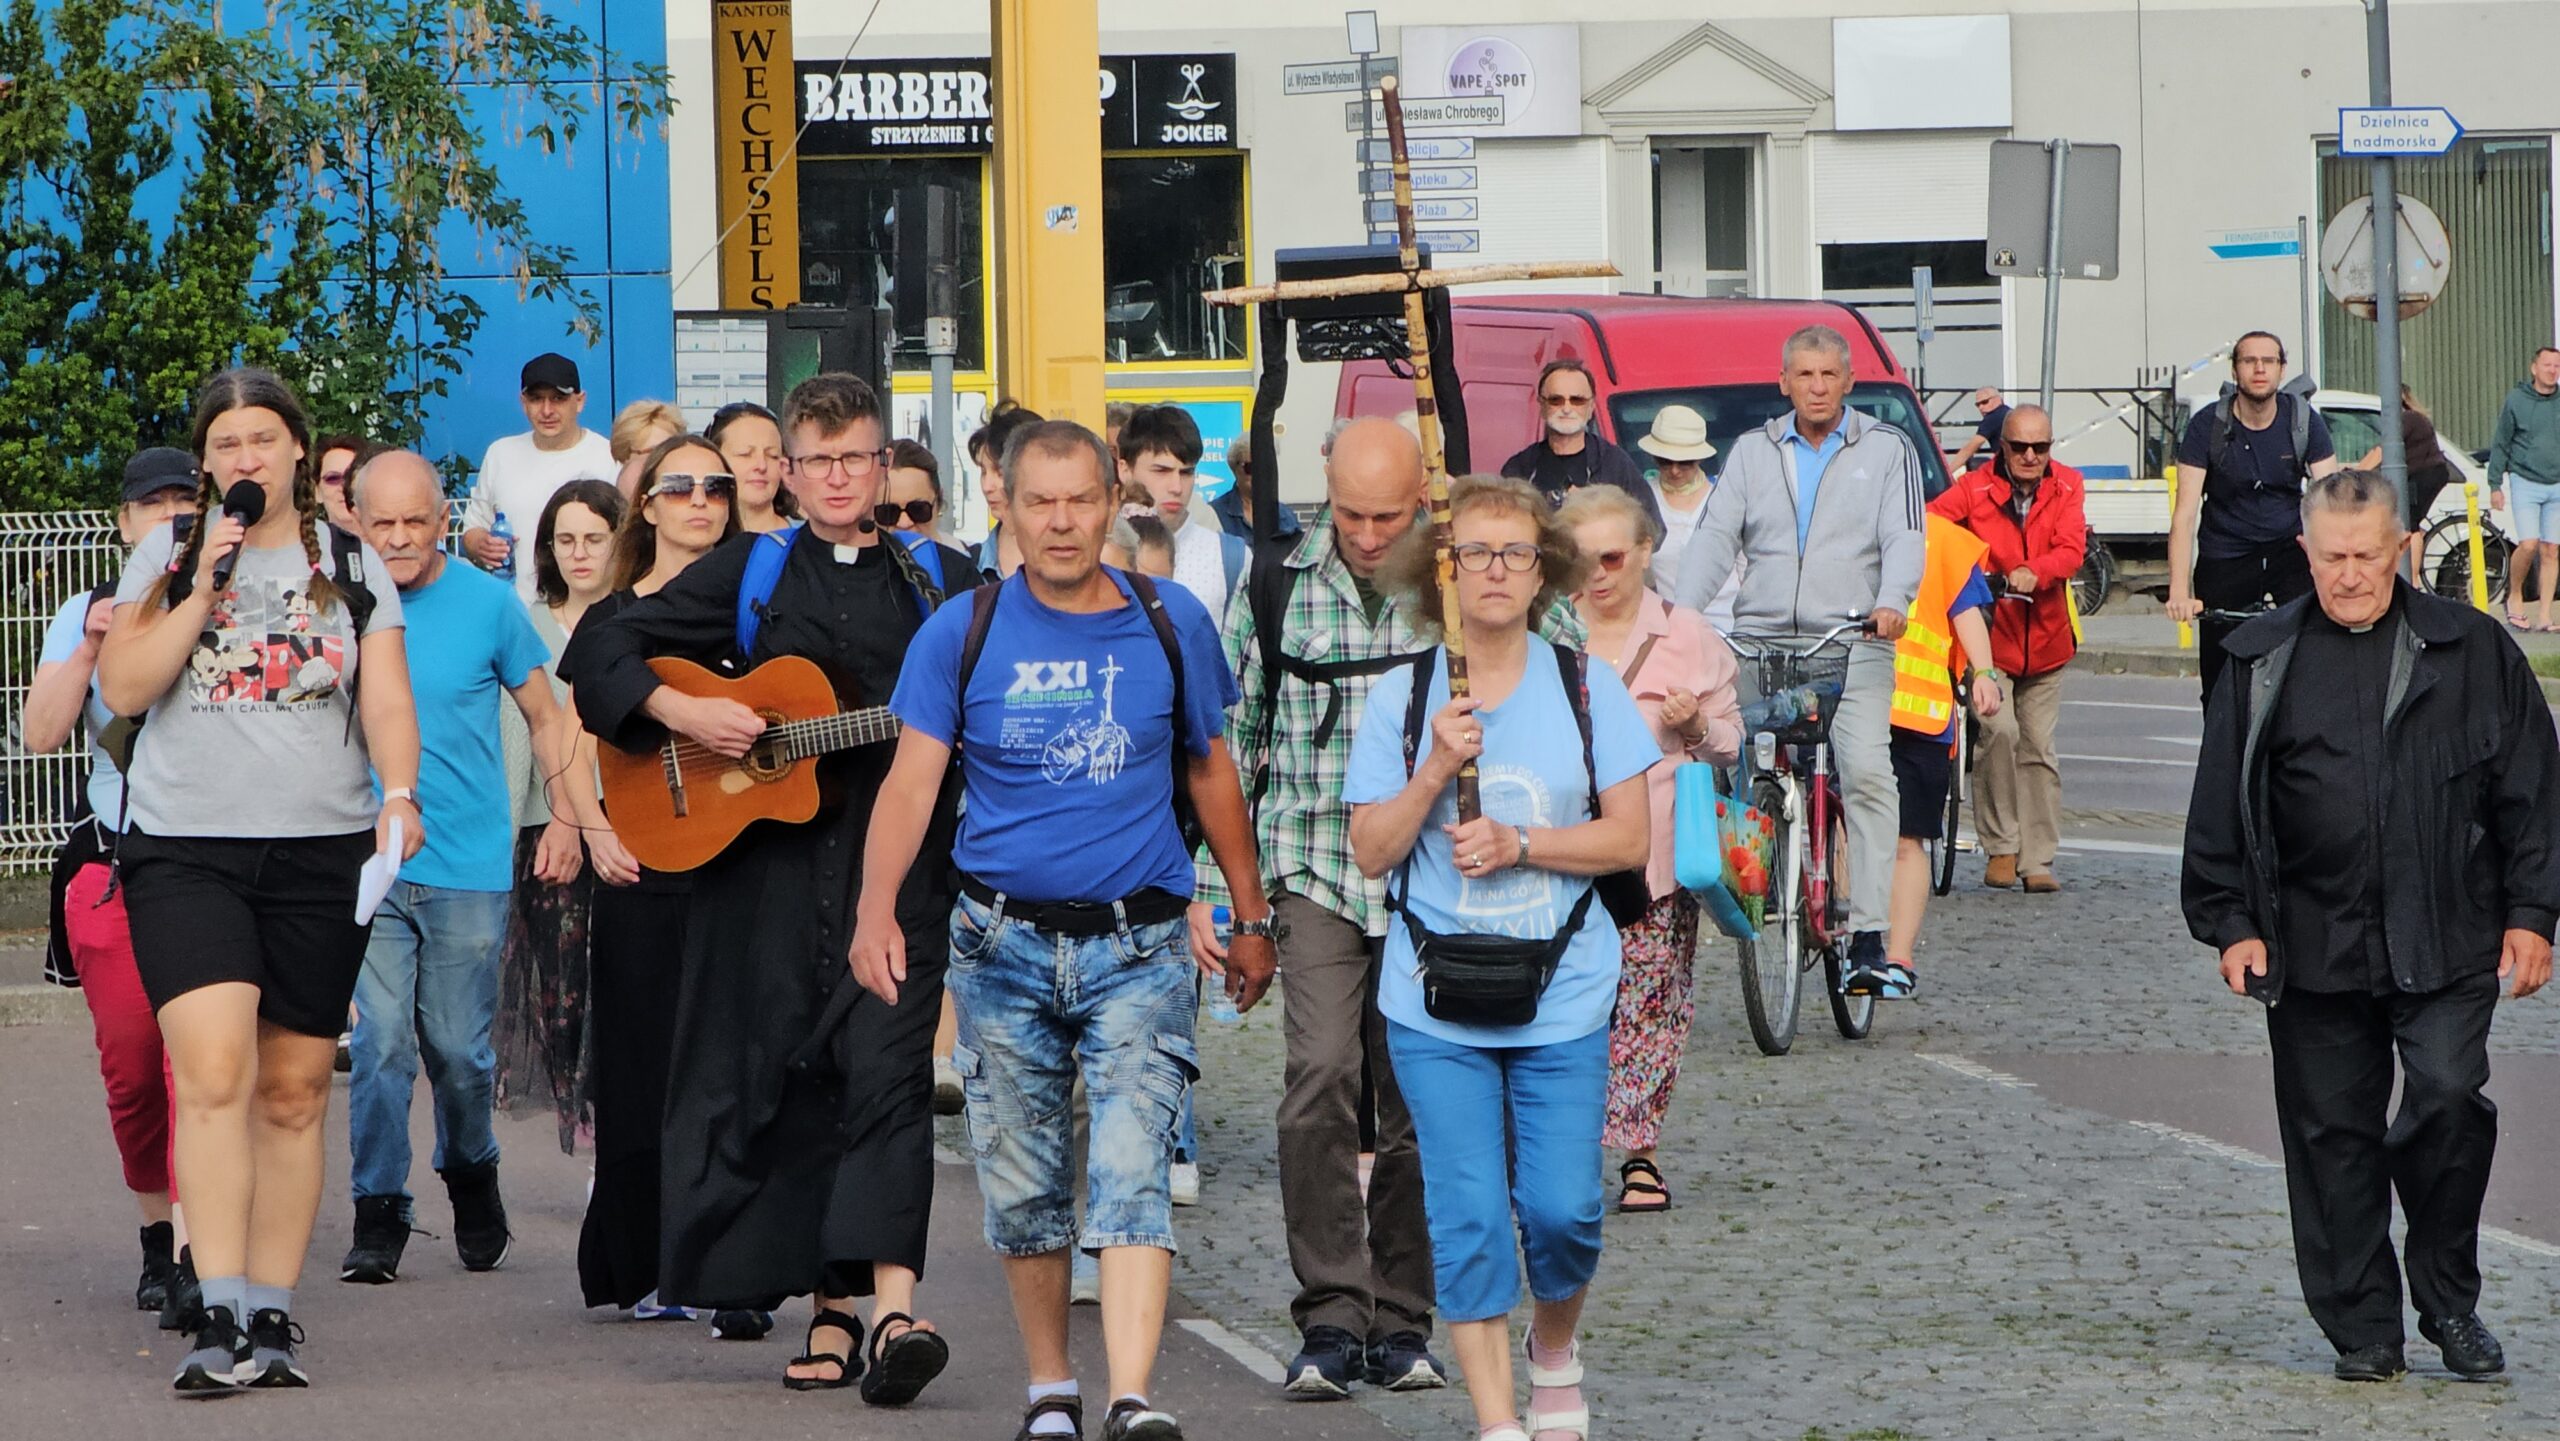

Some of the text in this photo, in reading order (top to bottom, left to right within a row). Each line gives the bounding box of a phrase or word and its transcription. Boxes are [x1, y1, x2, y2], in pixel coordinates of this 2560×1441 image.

[719, 4, 790, 17] KANTOR
[1450, 74, 1527, 88] VAPE SPOT
[1402, 106, 1442, 121] lesława
[1445, 104, 1499, 121] Chrobrego
[2360, 115, 2429, 128] Dzielnica
[871, 123, 966, 146] STRZYŻENIE
[971, 125, 979, 144] I
[1161, 124, 1228, 142] JOKER
[2353, 135, 2437, 148] nadmorska
[1408, 143, 1440, 159] olicja
[730, 29, 776, 310] WECHSELS
[1416, 203, 1447, 217] Plaża
[1005, 660, 1088, 696] XXI
[191, 704, 224, 713] WHEN
[240, 704, 269, 713] CALL
[276, 704, 292, 713] MY
[298, 701, 330, 712] CRUSH
